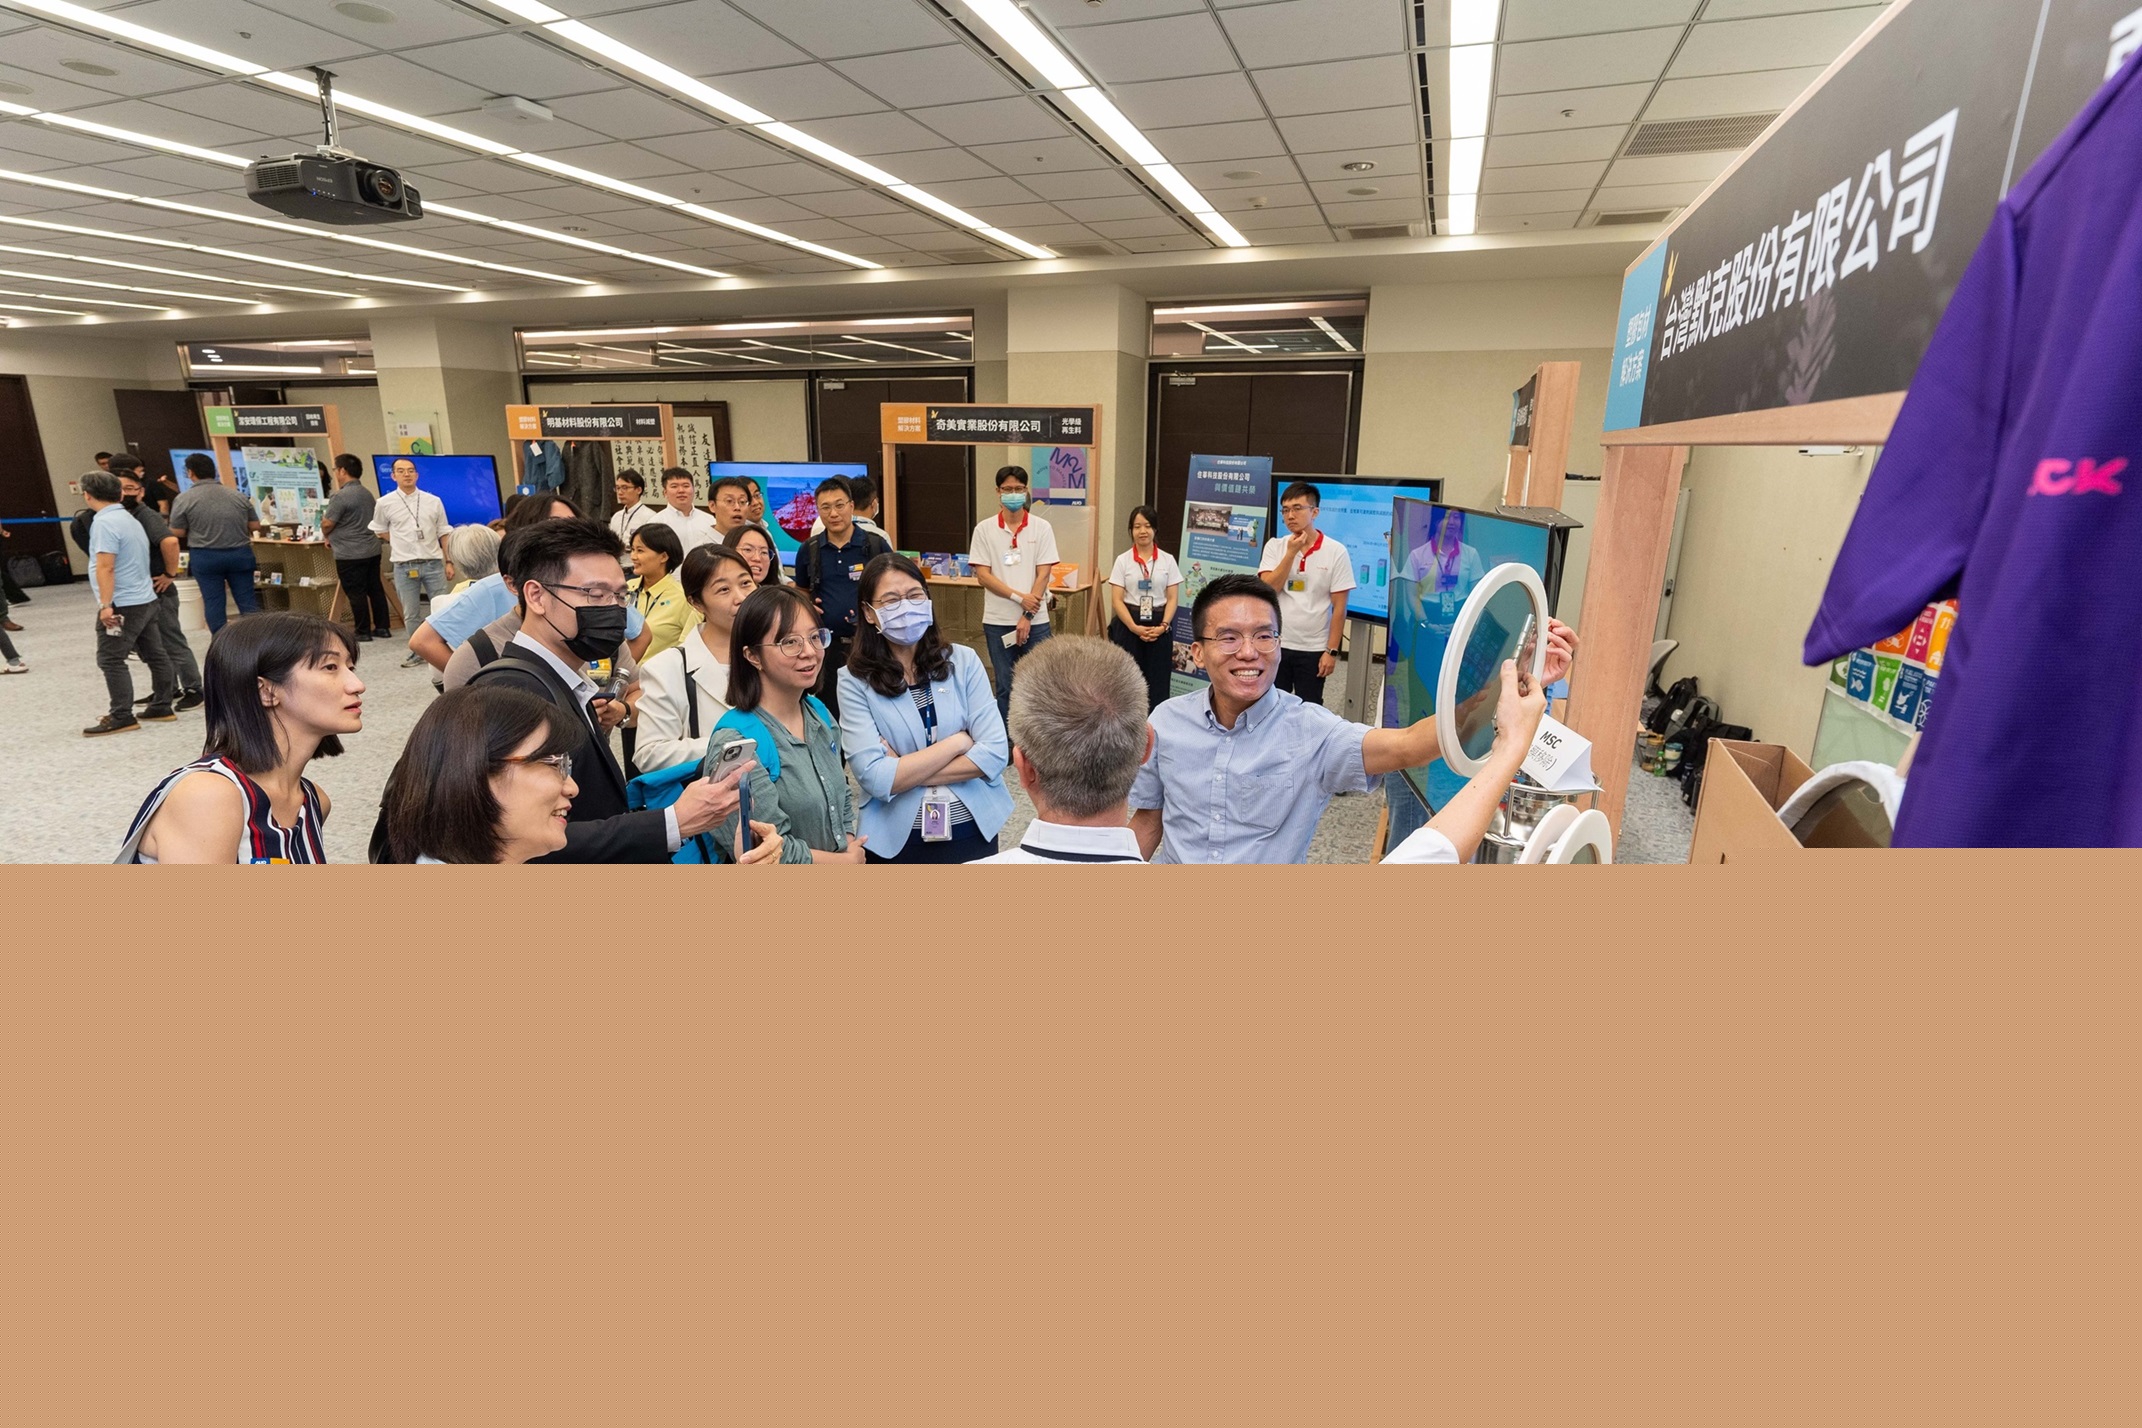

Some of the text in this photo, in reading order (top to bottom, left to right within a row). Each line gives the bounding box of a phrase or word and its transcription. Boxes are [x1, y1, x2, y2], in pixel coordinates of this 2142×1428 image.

[1660, 107, 1960, 361] 台灣默克股份有限公司
[546, 417, 624, 428] 明基材料股份有限公司
[936, 419, 1041, 433] 奇美實業股份有限公司
[1061, 417, 1082, 426] 光學級
[1061, 426, 1082, 434] 再生料
[1539, 730, 1563, 750] MSC
